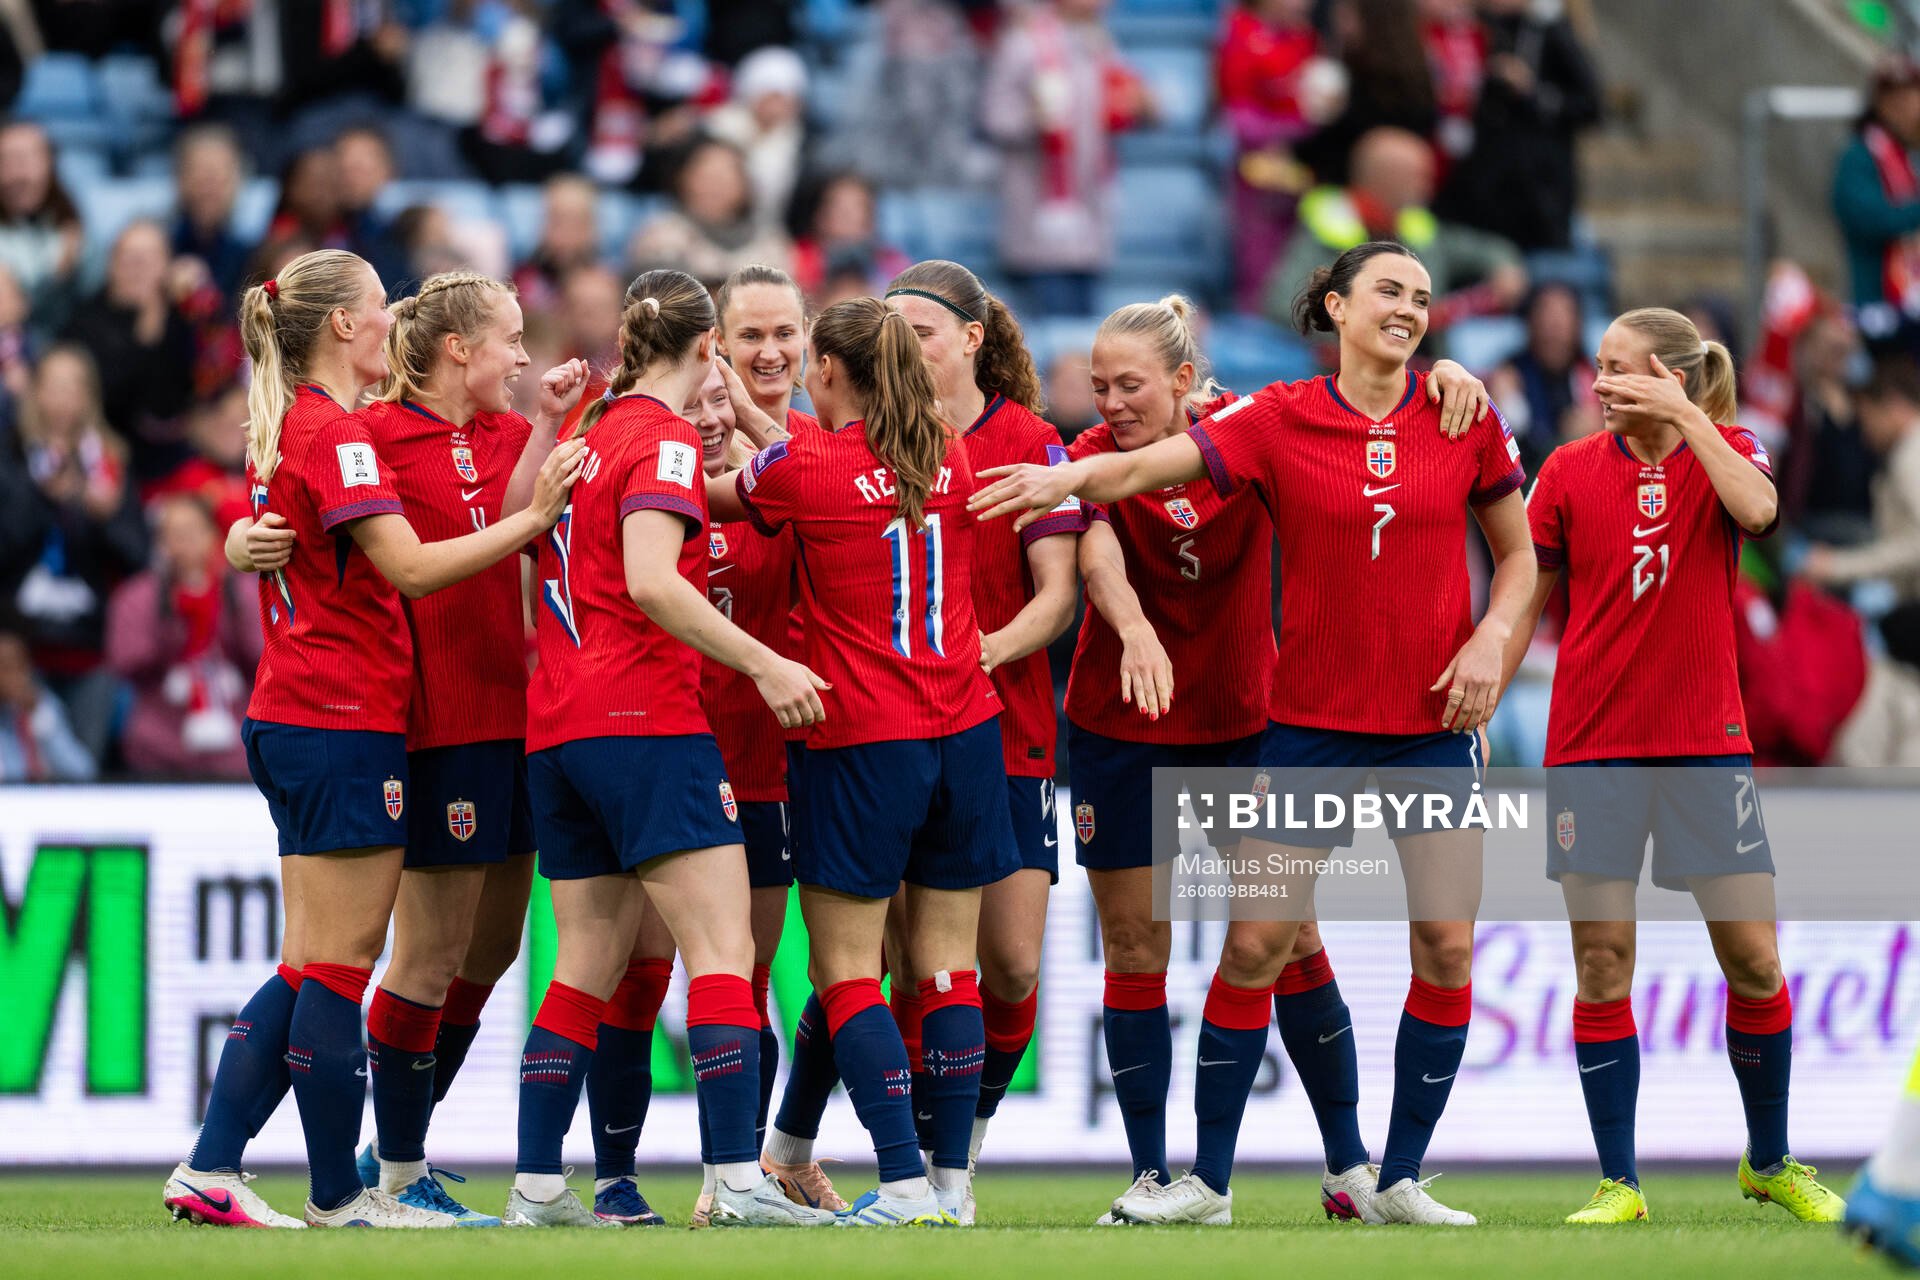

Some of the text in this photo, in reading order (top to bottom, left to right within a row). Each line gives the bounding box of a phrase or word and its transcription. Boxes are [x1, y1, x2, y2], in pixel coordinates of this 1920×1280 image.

[1178, 538, 1201, 581] 5
[1371, 503, 1397, 561] 7
[880, 513, 946, 659] 11
[1632, 543, 1670, 602] 21
